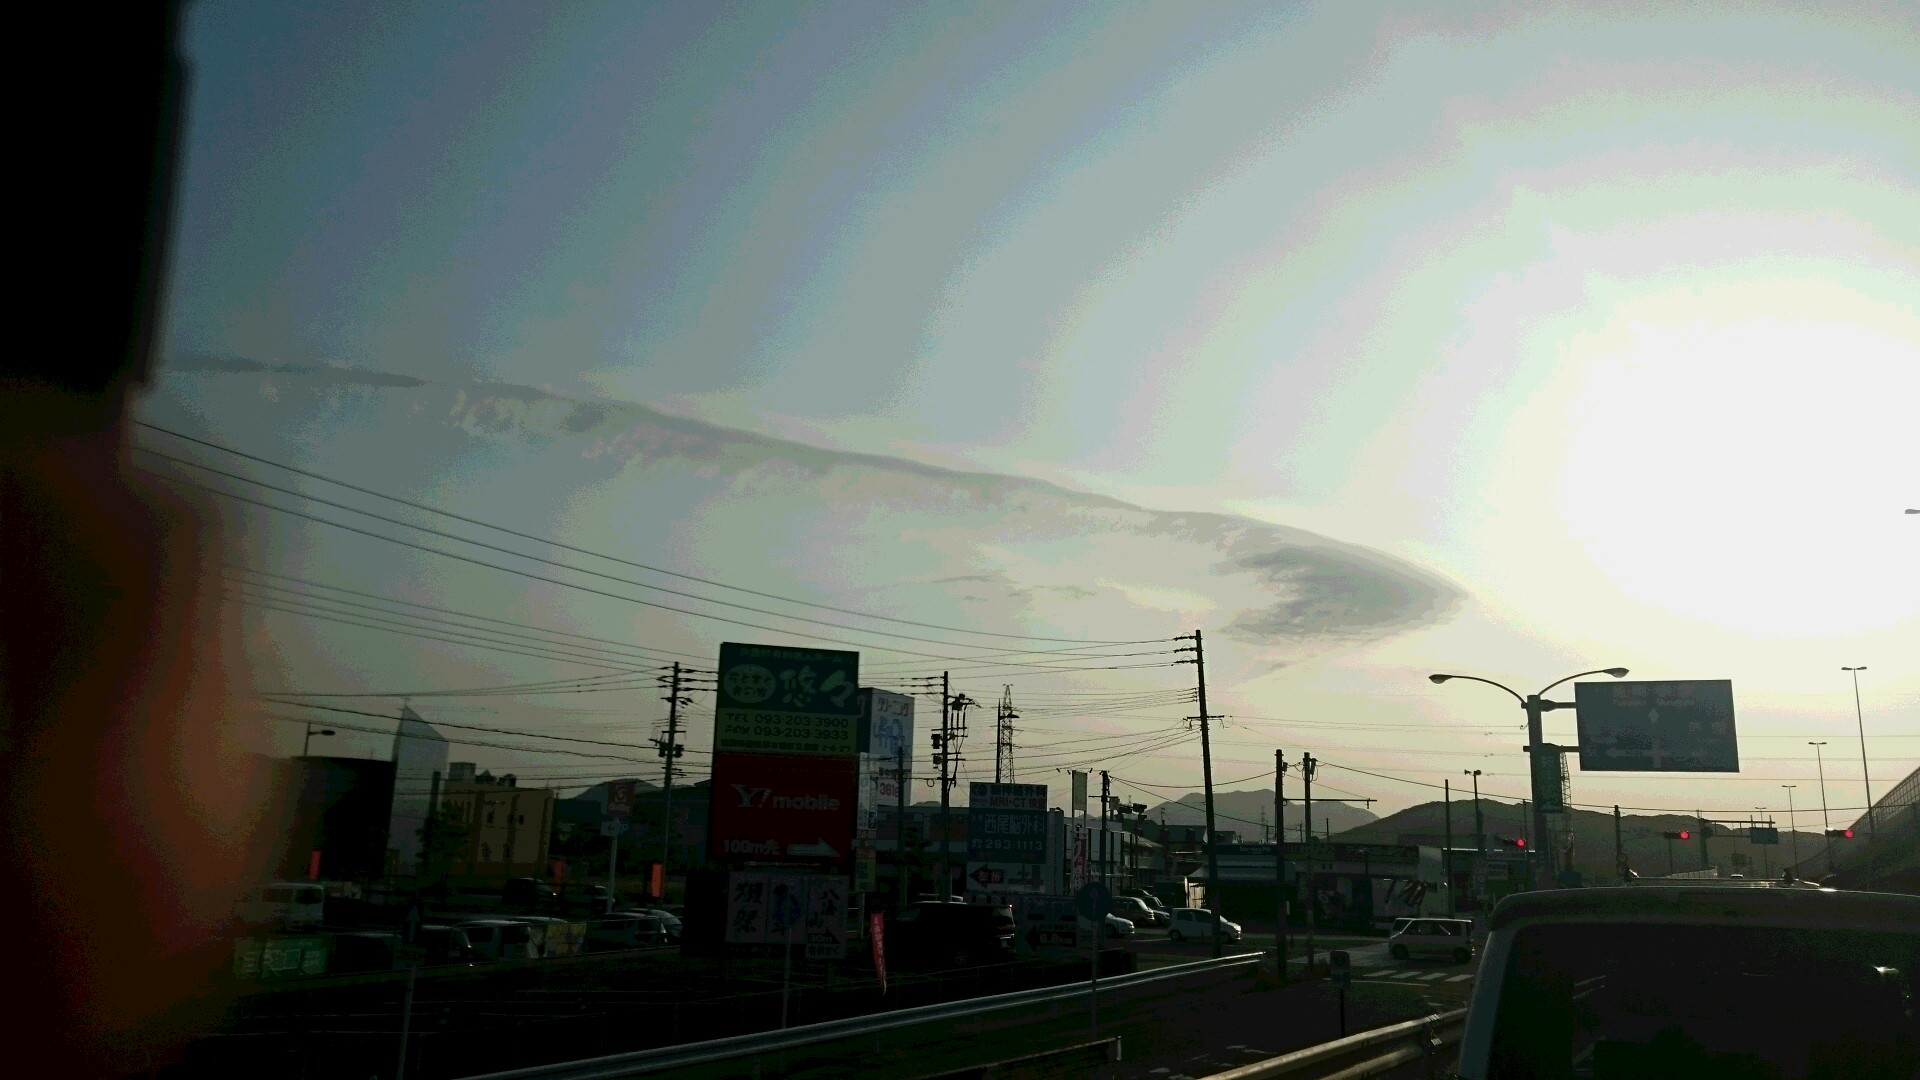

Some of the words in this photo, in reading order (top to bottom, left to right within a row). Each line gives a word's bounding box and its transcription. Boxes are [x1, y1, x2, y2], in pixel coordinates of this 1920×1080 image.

[726, 713, 750, 723] TEL
[985, 814, 1045, 835] 西尾脳外科
